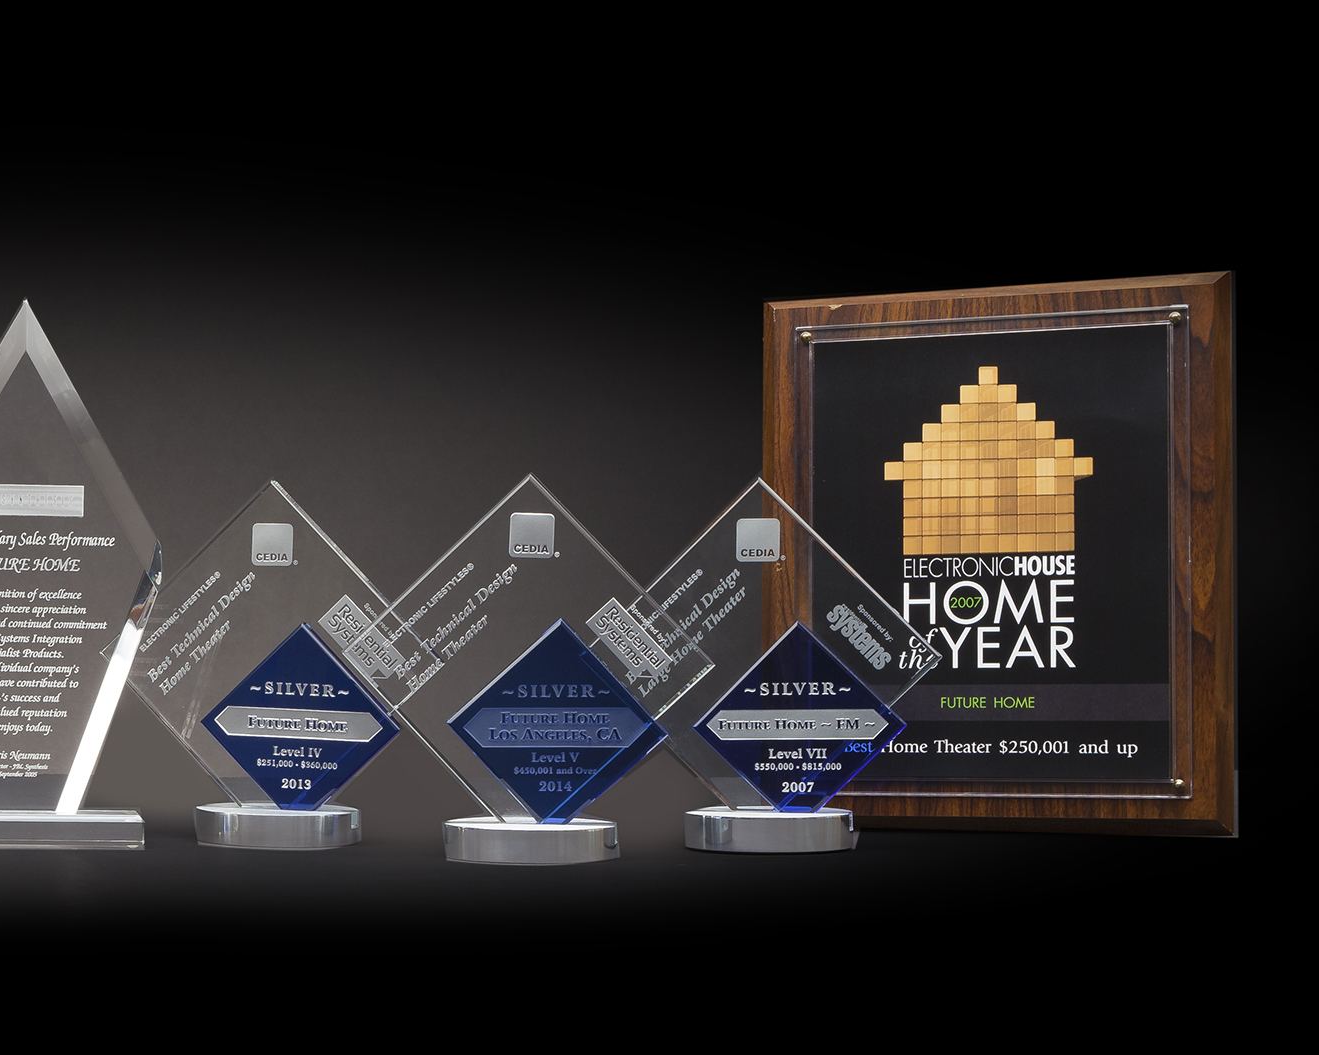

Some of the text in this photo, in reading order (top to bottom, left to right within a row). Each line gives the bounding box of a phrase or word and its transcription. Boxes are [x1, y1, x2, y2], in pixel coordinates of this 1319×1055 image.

[18, 531, 46, 546] Sales
[49, 532, 115, 551] Performance
[514, 545, 549, 554] CEDIA
[741, 549, 775, 557] CEDIA
[256, 553, 287, 562] CEDIA
[32, 558, 80, 572] HOME
[700, 568, 740, 609] Design
[28, 589, 37, 602] of
[39, 589, 82, 600] excellence
[903, 579, 1074, 624] HOME
[702, 585, 747, 631] Theater
[951, 597, 981, 608] 2007
[0, 605, 30, 614] sincere
[32, 605, 86, 617] appreciation
[8, 619, 51, 628] continued
[53, 620, 107, 630] commitment
[393, 650, 421, 680] Best
[420, 599, 477, 653] Technical
[474, 563, 518, 605] Design
[857, 604, 886, 633] Sponsored
[139, 613, 180, 652] ELECTRONIC
[147, 571, 256, 683] Best Technical Design
[32, 634, 82, 647] Integration
[441, 614, 488, 660] Theater
[595, 616, 643, 667] Systems
[605, 607, 665, 669] Residential
[826, 605, 891, 670] systems
[939, 625, 1076, 669] YEAR
[22, 649, 64, 658] Products.
[159, 619, 231, 695] Home Theater
[17, 678, 68, 688] contributed
[10, 693, 60, 703] success and
[940, 697, 1034, 709] FUTURE HOME
[21, 708, 67, 720] reputation
[499, 711, 610, 724] FUTURE HOME
[26, 722, 53, 735] today.
[247, 715, 348, 733] FUTURE HOME
[718, 719, 816, 730] FUTURE HOME
[596, 727, 622, 741] CA
[273, 746, 322, 758] Level IV
[768, 748, 827, 759] Level VII
[881, 740, 1138, 757] Home Theater $250,001 and up
[10, 750, 51, 761] Neumann
[531, 752, 579, 763] Level V
[257, 758, 293, 768] $251,000
[755, 762, 841, 771] $550,000 $815,000
[514, 766, 553, 775] $450,001
[576, 767, 597, 775] Over
[281, 778, 311, 790] 2013
[539, 781, 572, 792] 2014
[782, 782, 814, 792] 2007
